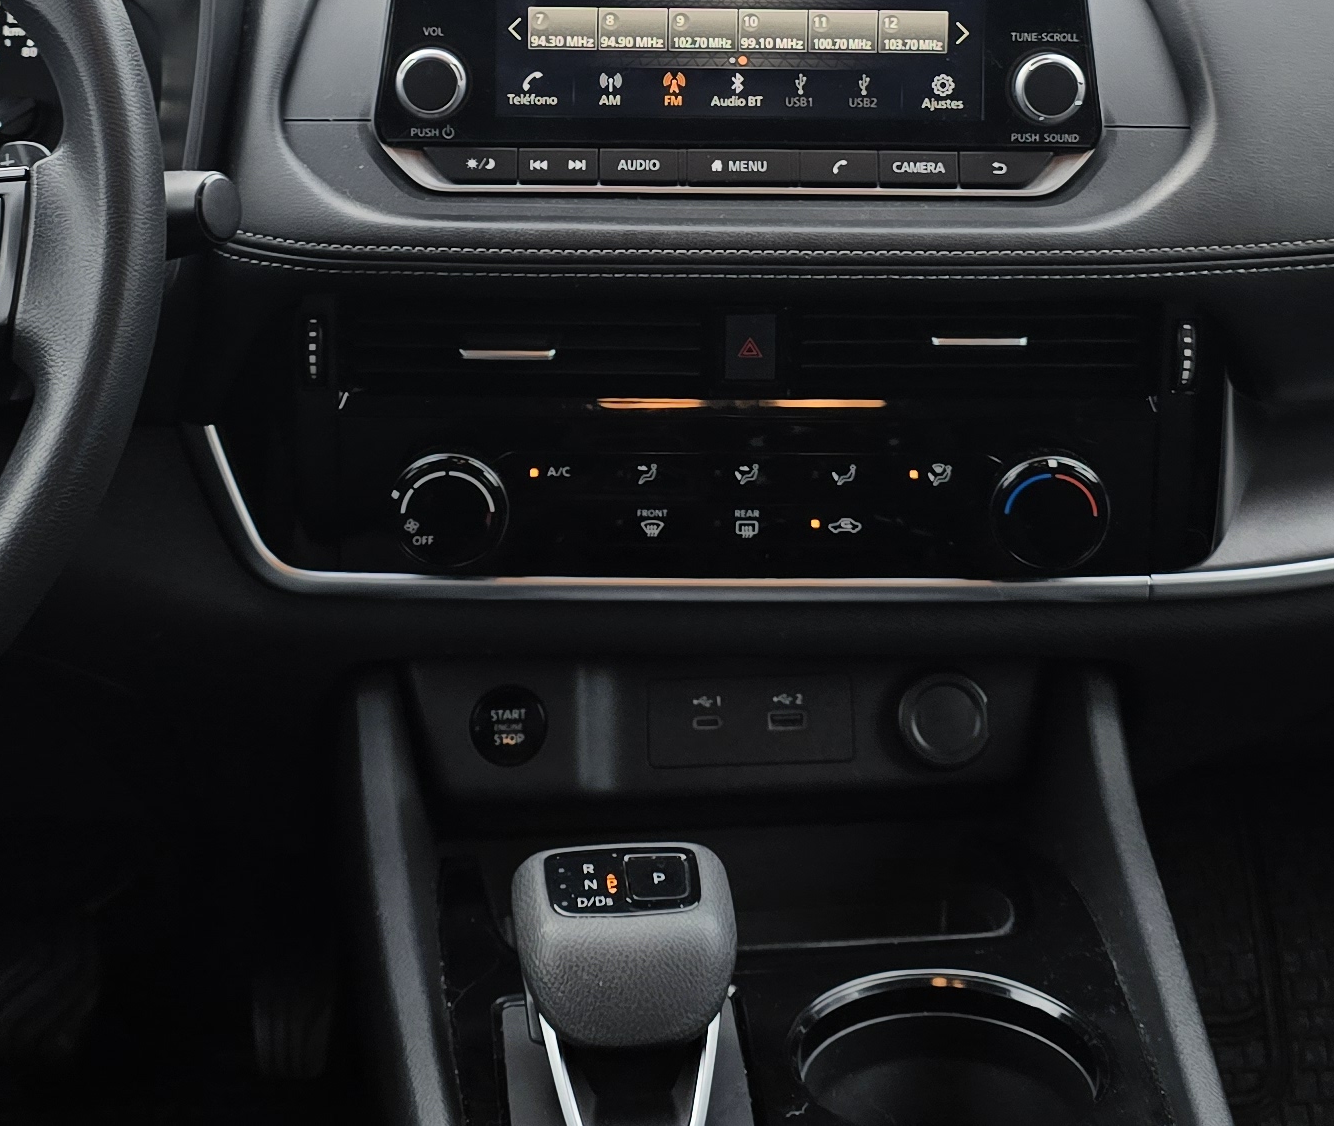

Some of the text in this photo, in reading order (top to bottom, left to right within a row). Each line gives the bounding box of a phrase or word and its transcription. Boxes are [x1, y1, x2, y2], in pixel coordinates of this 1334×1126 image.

[535, 13, 544, 24] 7
[605, 14, 615, 25] 8
[675, 15, 685, 27] 9
[743, 15, 759, 27] 10
[813, 16, 828, 28] 11
[883, 17, 899, 28] 12
[423, 27, 444, 37] VOL
[530, 35, 594, 48] 94.30 MHz
[600, 35, 663, 48] 94.90 MHz
[673, 36, 732, 49] 102.70 MHz
[740, 37, 804, 49] 99.10 MHz
[813, 38, 872, 50] 100.70 MHz
[883, 39, 943, 51] 103.70 MHz
[506, 93, 558, 105] Teléfono
[598, 95, 621, 106] AM
[664, 95, 683, 106] FM
[710, 96, 763, 107] Audio BT
[785, 97, 813, 107] USB1
[848, 97, 877, 108] USB2
[921, 98, 964, 112] Ajustes
[410, 128, 439, 137] PUSH
[1011, 133, 1079, 143] PUSH SOUND
[617, 159, 660, 172] AUDIO
[728, 160, 768, 172] MENU
[892, 161, 946, 174] CAMERA
[547, 466, 571, 478] A/C
[637, 509, 668, 518] FRONT
[734, 509, 760, 518] REAR
[412, 535, 434, 546] OFF
[716, 695, 722, 706] 1
[795, 693, 803, 705] 2
[490, 708, 526, 721] START
[494, 733, 525, 745] STOP
[583, 863, 595, 874] R
[584, 879, 598, 890] N
[652, 872, 666, 885] P
